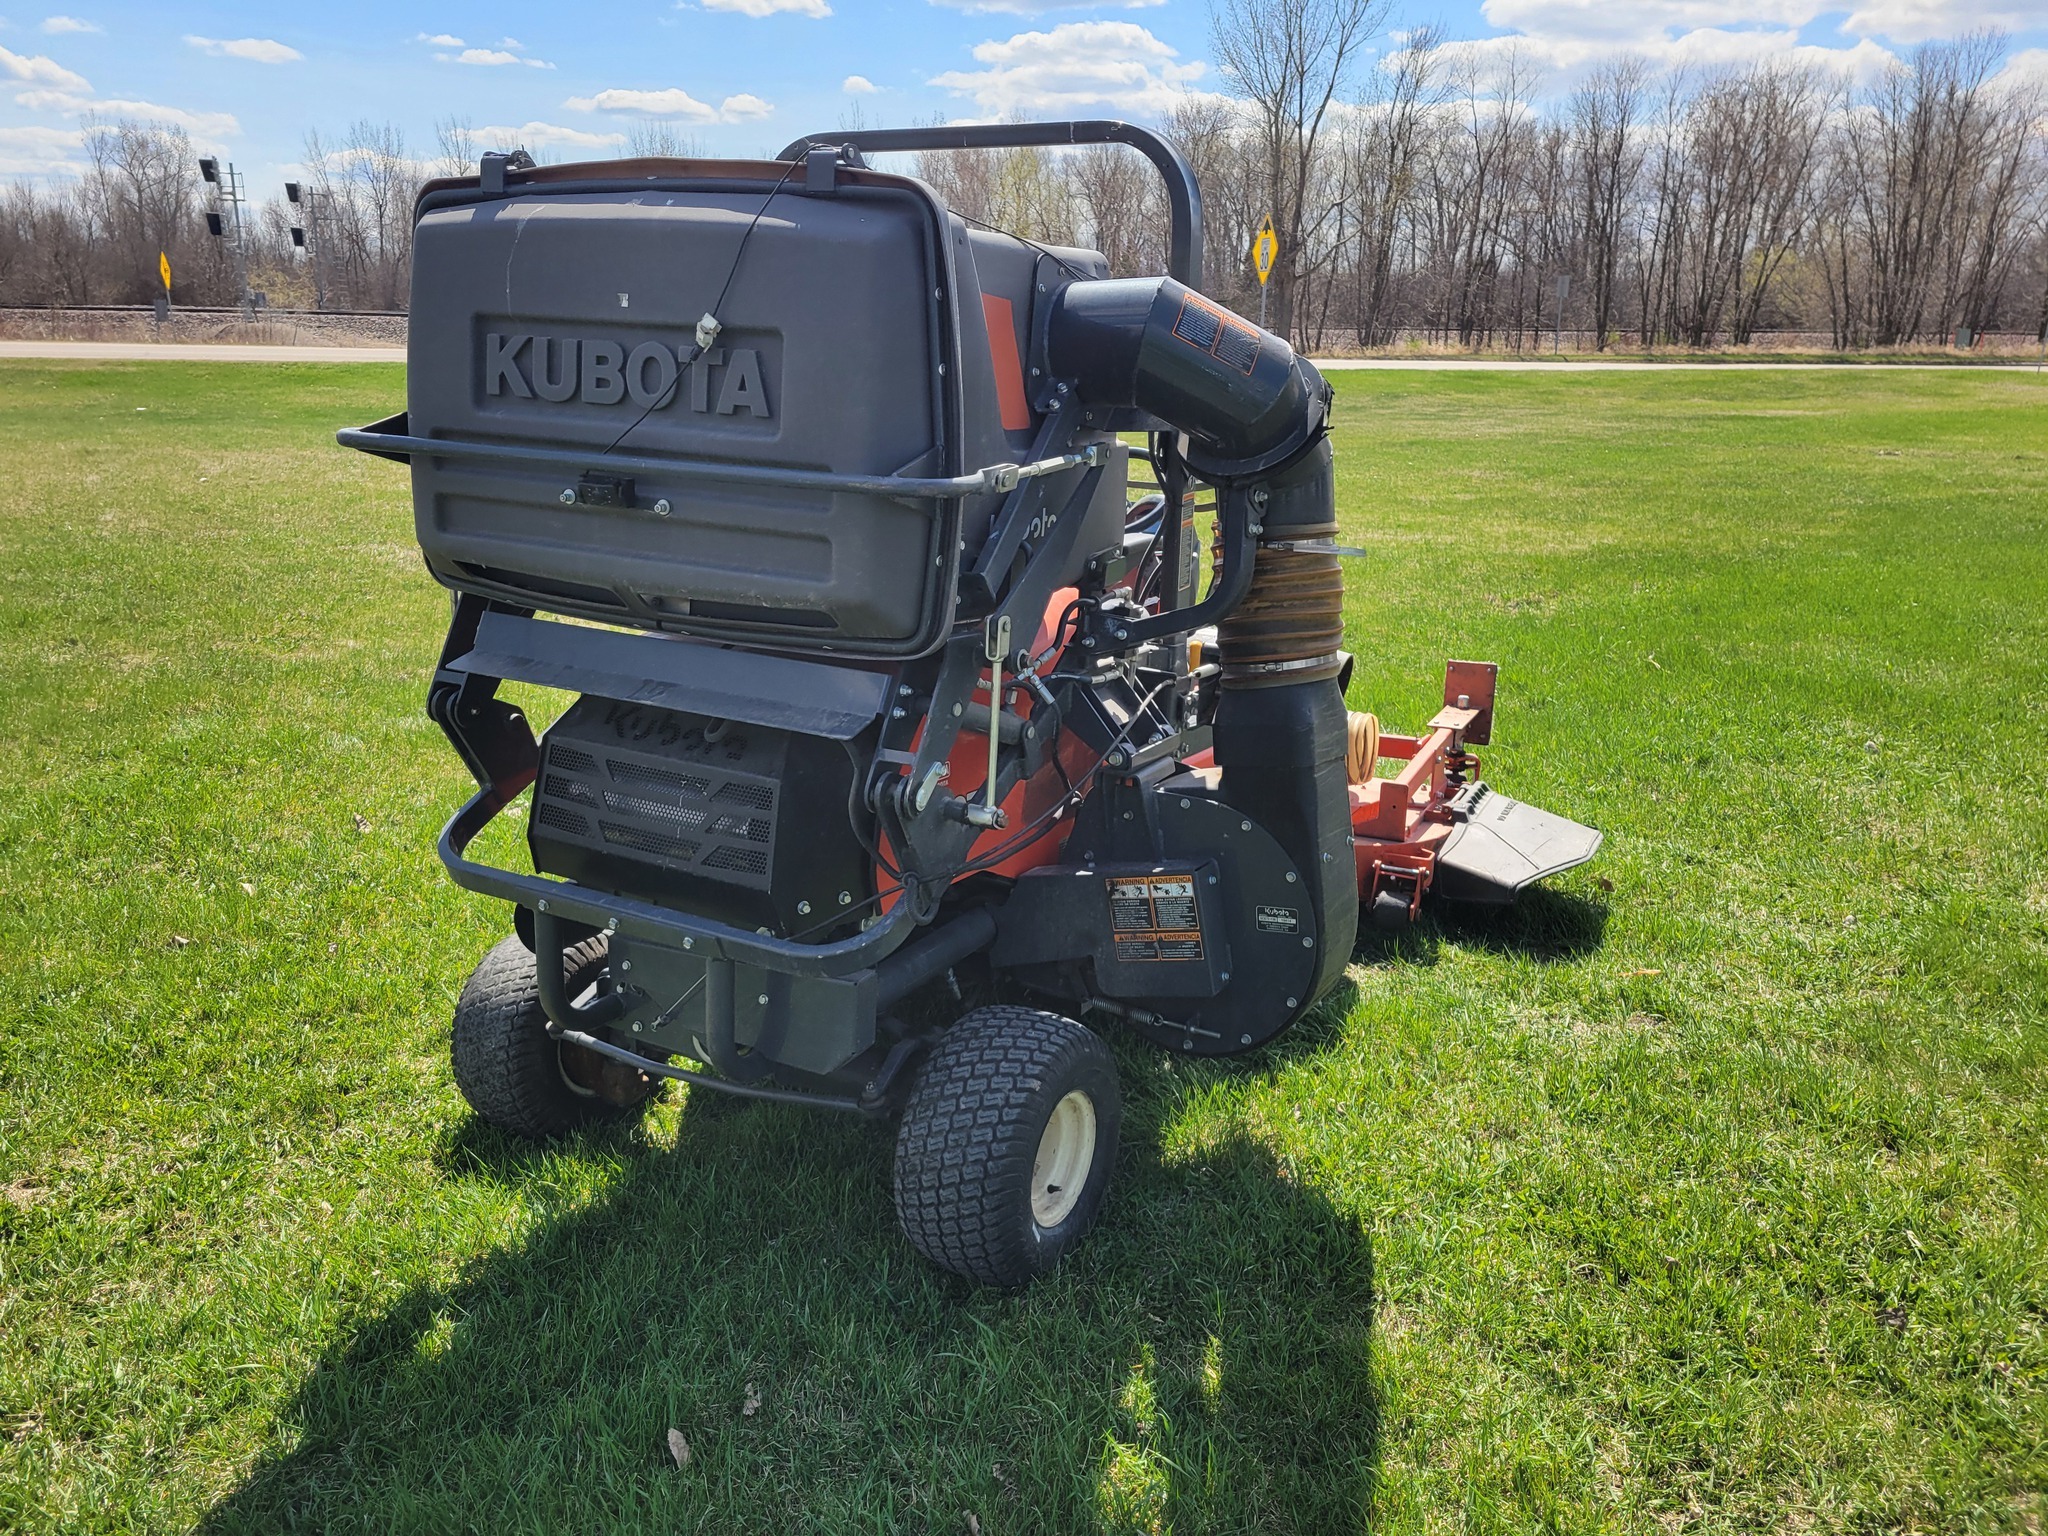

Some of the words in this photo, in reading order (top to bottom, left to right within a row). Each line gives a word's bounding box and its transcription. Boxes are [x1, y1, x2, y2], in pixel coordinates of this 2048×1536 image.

[485, 333, 771, 418] KUBOTA
[1155, 876, 1191, 884] ADVERTENCIA
[1264, 907, 1290, 916] Kubota
